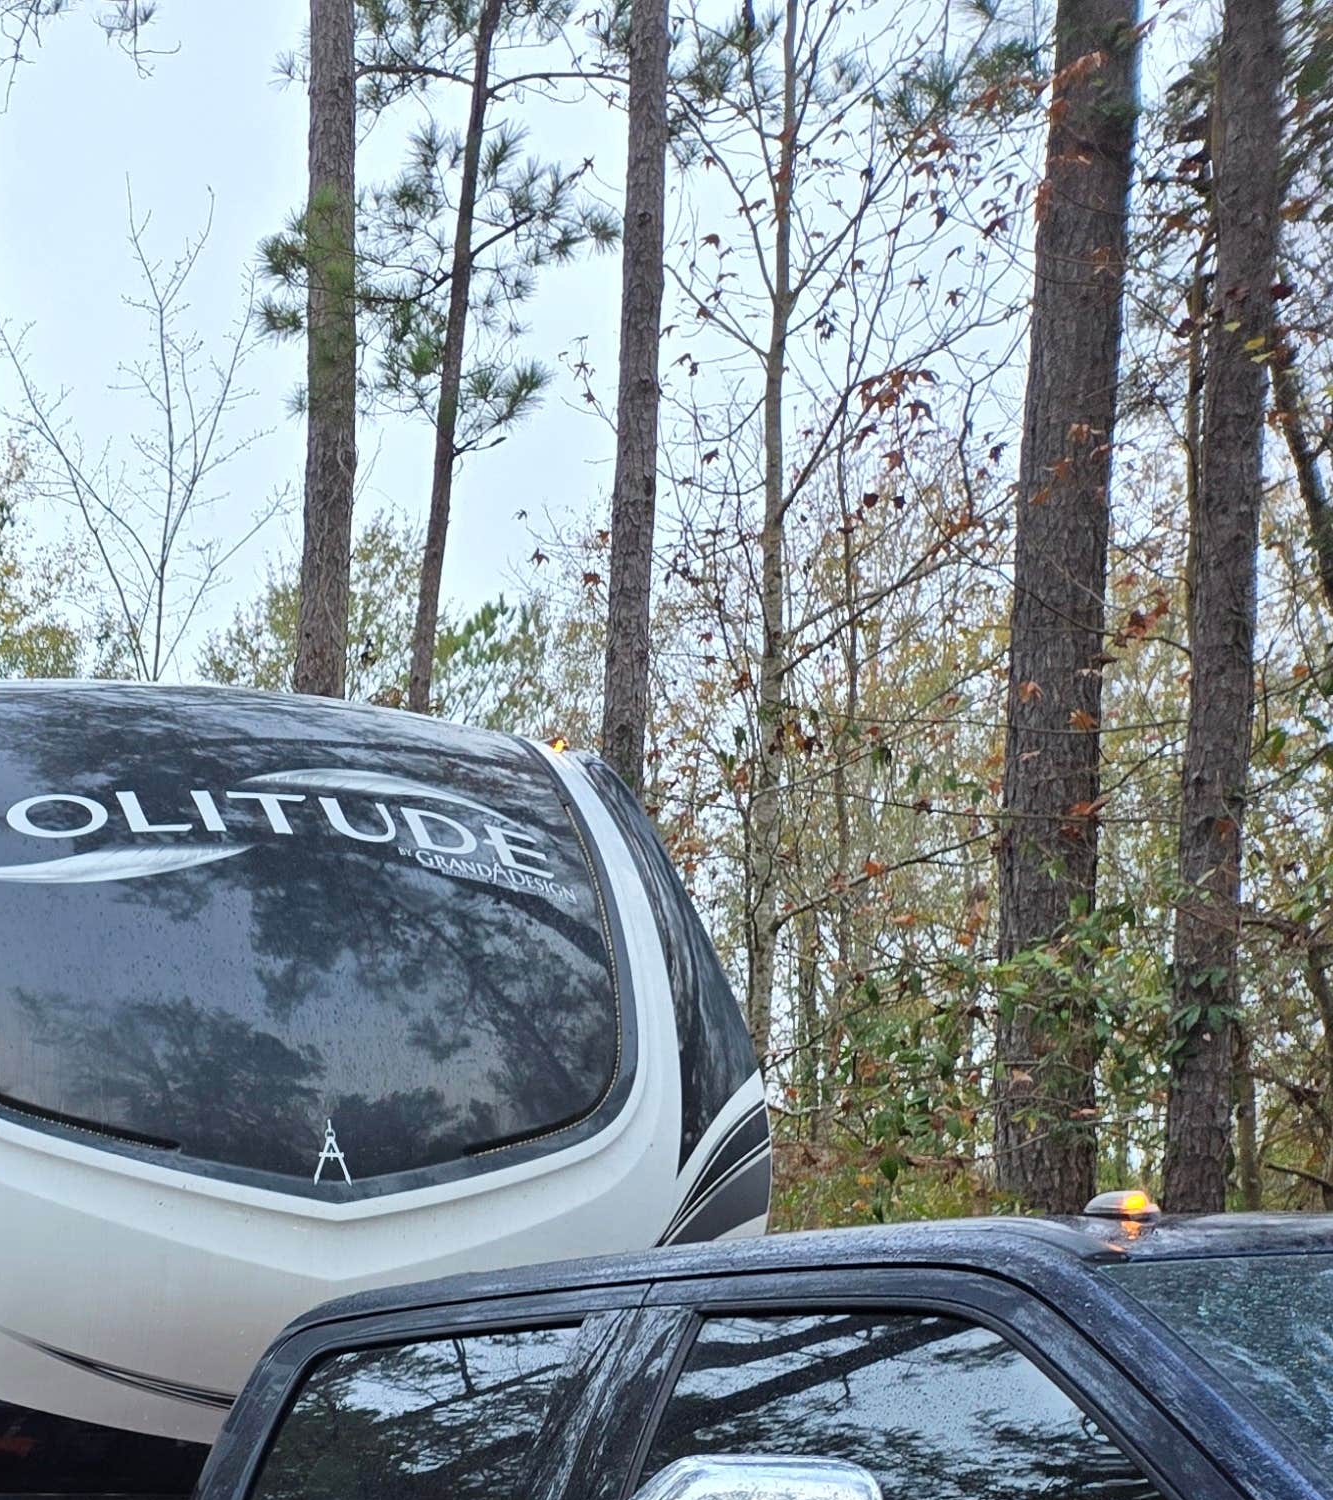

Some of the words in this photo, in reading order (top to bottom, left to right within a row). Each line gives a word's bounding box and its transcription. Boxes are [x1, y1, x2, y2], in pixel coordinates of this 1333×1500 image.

[397, 846, 413, 857] BY
[415, 850, 493, 880] GRAND
[509, 868, 578, 904] DESIGN
